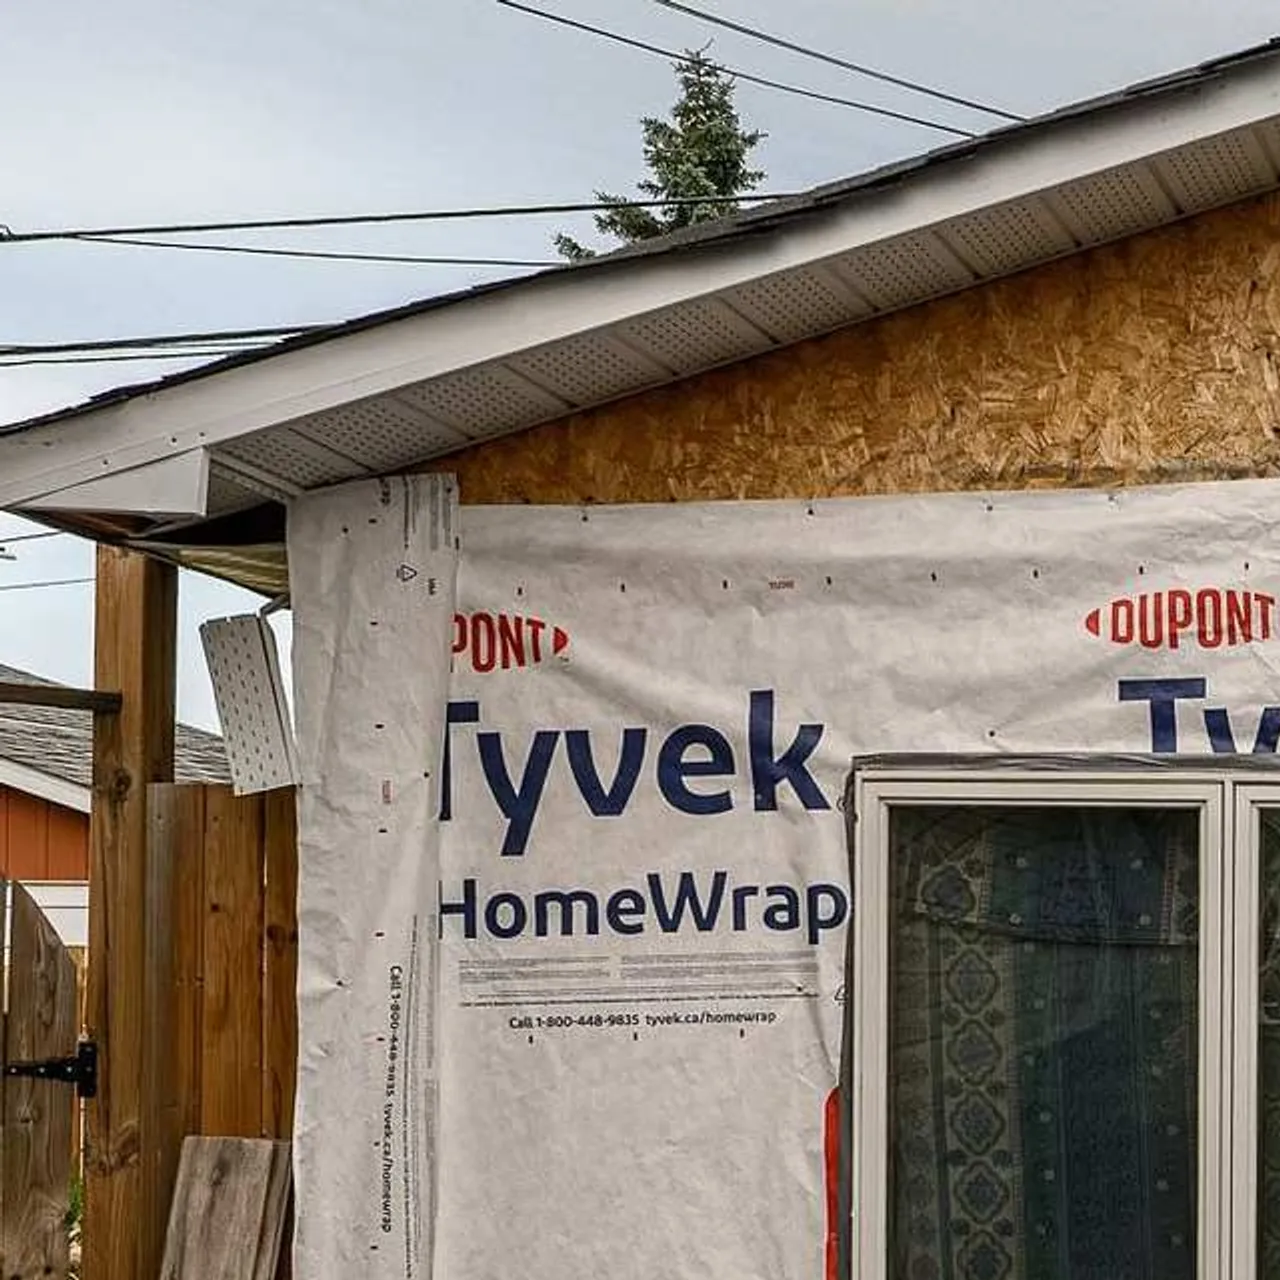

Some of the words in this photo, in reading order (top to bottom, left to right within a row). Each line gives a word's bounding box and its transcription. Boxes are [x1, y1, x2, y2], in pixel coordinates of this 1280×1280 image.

[1109, 587, 1276, 650] DUPONT
[438, 871, 850, 945] HomeWrap
[509, 1016, 534, 1030] Call
[536, 1013, 640, 1028] 1-800-448-9835
[645, 1010, 777, 1027] tyvek.ca/homewrap
